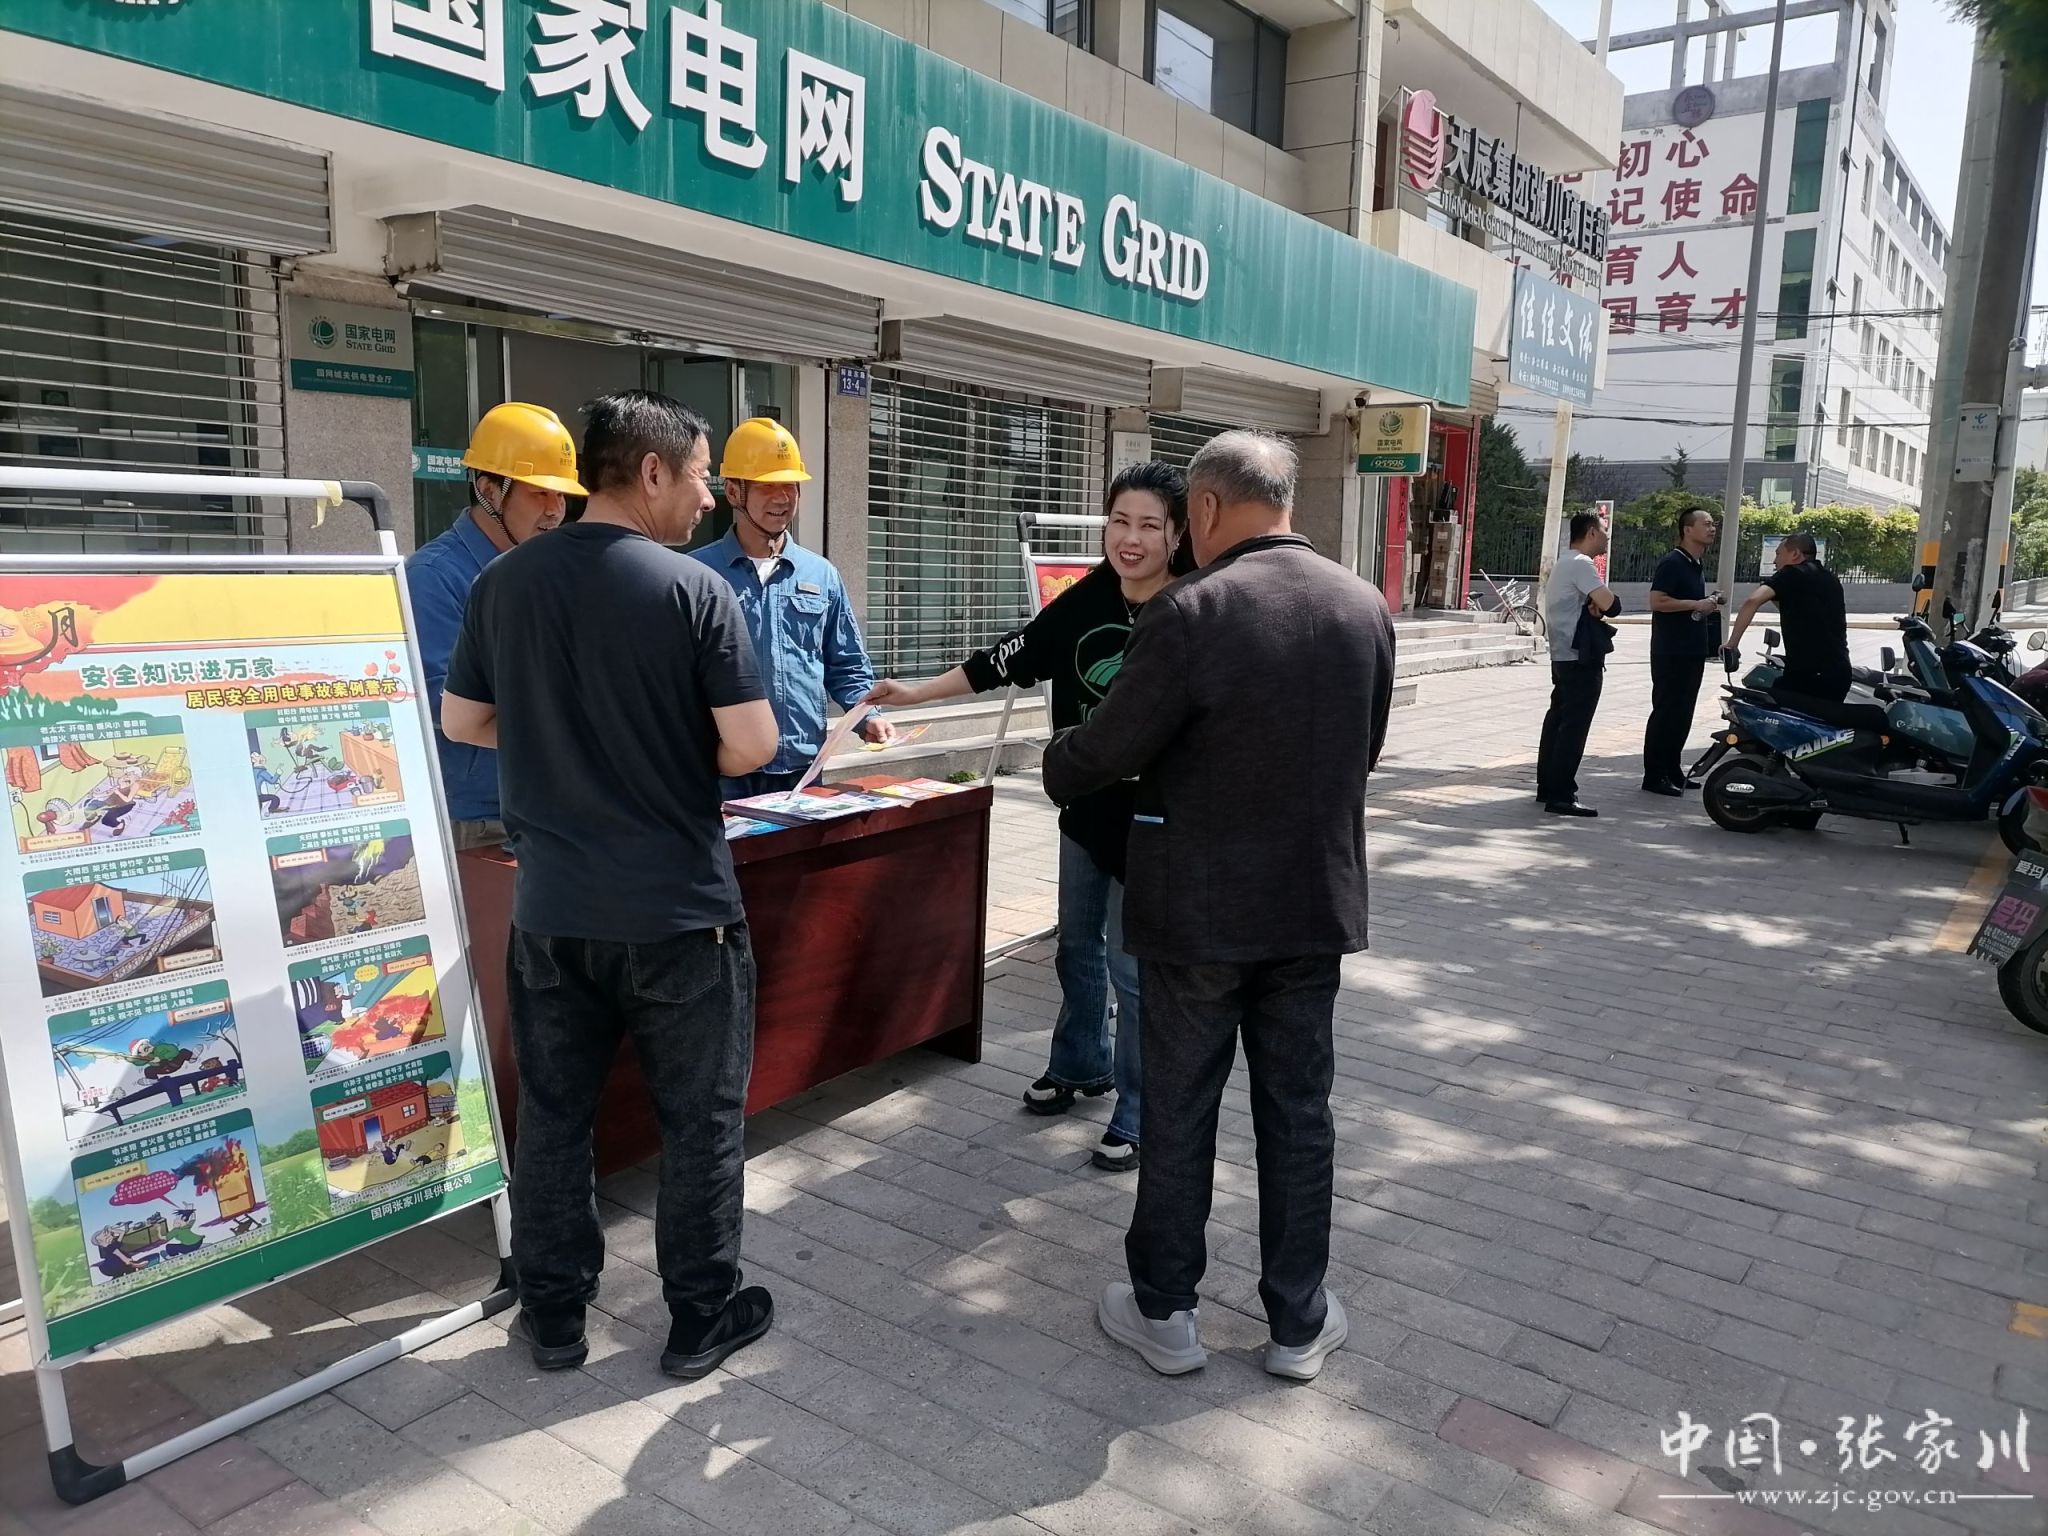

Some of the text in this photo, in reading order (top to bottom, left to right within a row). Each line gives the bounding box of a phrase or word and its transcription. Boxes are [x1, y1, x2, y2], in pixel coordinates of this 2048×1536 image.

[920, 126, 1209, 301] STATE GRID
[345, 323, 396, 344] 国家电网
[346, 340, 396, 354] STATE GRID
[81, 656, 277, 690] 安全知识进万家
[186, 679, 398, 709] 居民安全用电事故案例警示
[40, 726, 66, 734] 老太太
[147, 855, 169, 864] 人触电
[121, 867, 144, 877] 高压电
[371, 1173, 472, 1220] 国网张家川县供电公司
